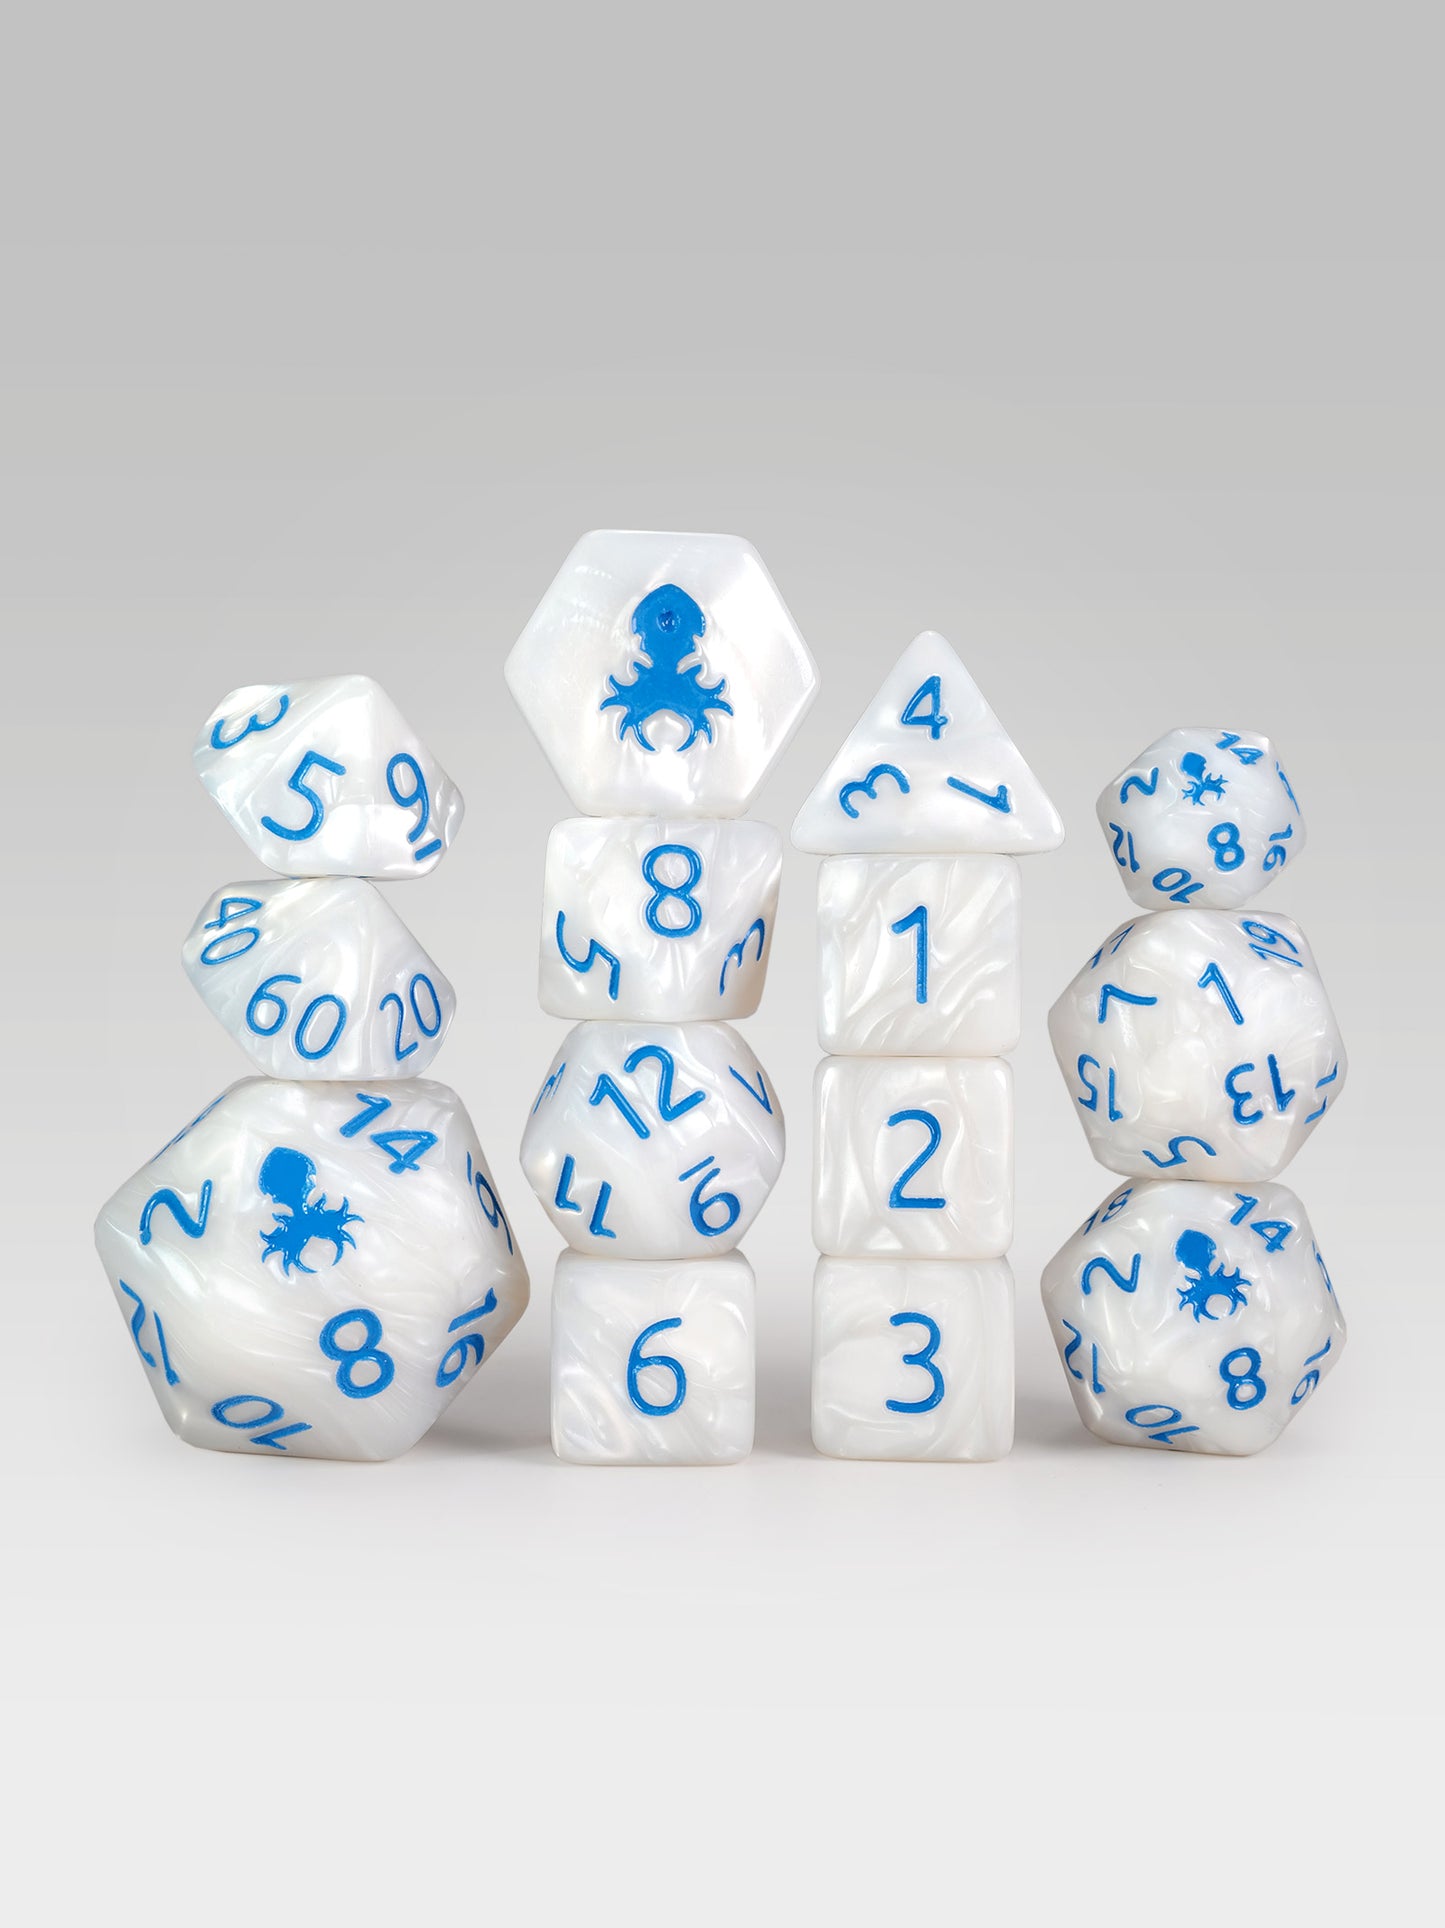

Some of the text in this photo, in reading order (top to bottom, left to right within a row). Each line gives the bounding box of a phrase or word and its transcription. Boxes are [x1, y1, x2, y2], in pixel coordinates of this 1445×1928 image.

[211, 695, 289, 750] 3
[900, 676, 948, 740] 4
[1216, 732, 1264, 765] 14
[261, 750, 345, 841] 5
[386, 753, 442, 861] 9
[839, 764, 910, 818] 3
[947, 777, 1010, 813] 1
[1120, 768, 1159, 804] 2
[1110, 823, 1141, 873] 12
[1207, 822, 1245, 871] 8
[1262, 823, 1293, 872] 16
[642, 844, 702, 938] 8
[1152, 868, 1205, 904] 10
[200, 897, 263, 965] 40
[556, 911, 621, 1001] 5
[720, 918, 766, 996] 3
[892, 906, 928, 1004] 1
[1242, 920, 1303, 968] 19
[246, 974, 347, 1060] 60
[379, 973, 443, 1062] 20
[1098, 984, 1157, 1024] 7
[1198, 963, 1245, 1026] 1
[589, 1044, 706, 1140] 12
[1078, 1053, 1124, 1123] 15
[1225, 1053, 1296, 1126] 13
[340, 1093, 438, 1175] 14
[888, 1110, 946, 1208] 2
[1143, 1136, 1217, 1169] 5
[140, 1180, 213, 1246] 2
[555, 1155, 617, 1239] 11
[1230, 1193, 1293, 1254] 14
[1081, 1254, 1142, 1296] 2
[119, 1279, 181, 1388] 12
[319, 1309, 396, 1400] 8
[436, 1287, 498, 1388] 16
[627, 1318, 687, 1417] 6
[886, 1312, 945, 1414] 3
[1063, 1319, 1106, 1395] 12
[1219, 1347, 1267, 1411] 8
[211, 1395, 313, 1451] 10
[1125, 1405, 1200, 1445] 10
